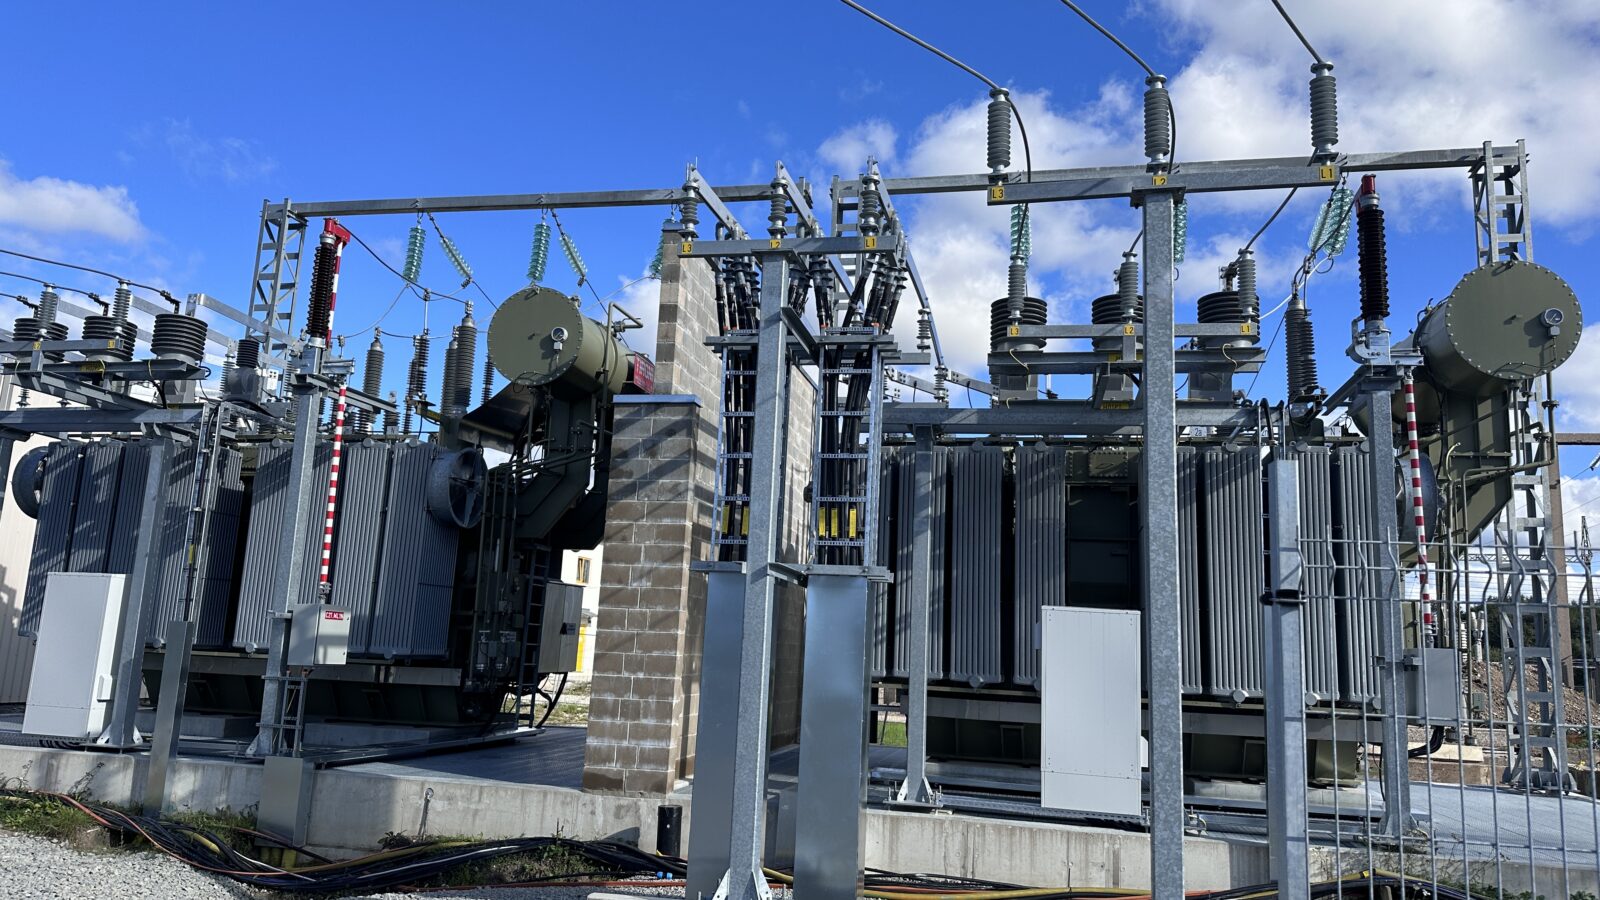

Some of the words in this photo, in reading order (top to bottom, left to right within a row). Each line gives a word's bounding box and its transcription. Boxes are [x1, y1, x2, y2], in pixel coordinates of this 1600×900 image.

[1321, 168, 1333, 179] L1
[1154, 177, 1166, 186] L2
[992, 188, 1004, 199] L3
[770, 241, 780, 249] L2
[865, 238, 875, 248] L1
[682, 243, 692, 253] L3
[1010, 327, 1019, 336] L3
[1124, 326, 1134, 335] L2
[1241, 325, 1250, 333] L1
[1194, 427, 1203, 437] 2a
